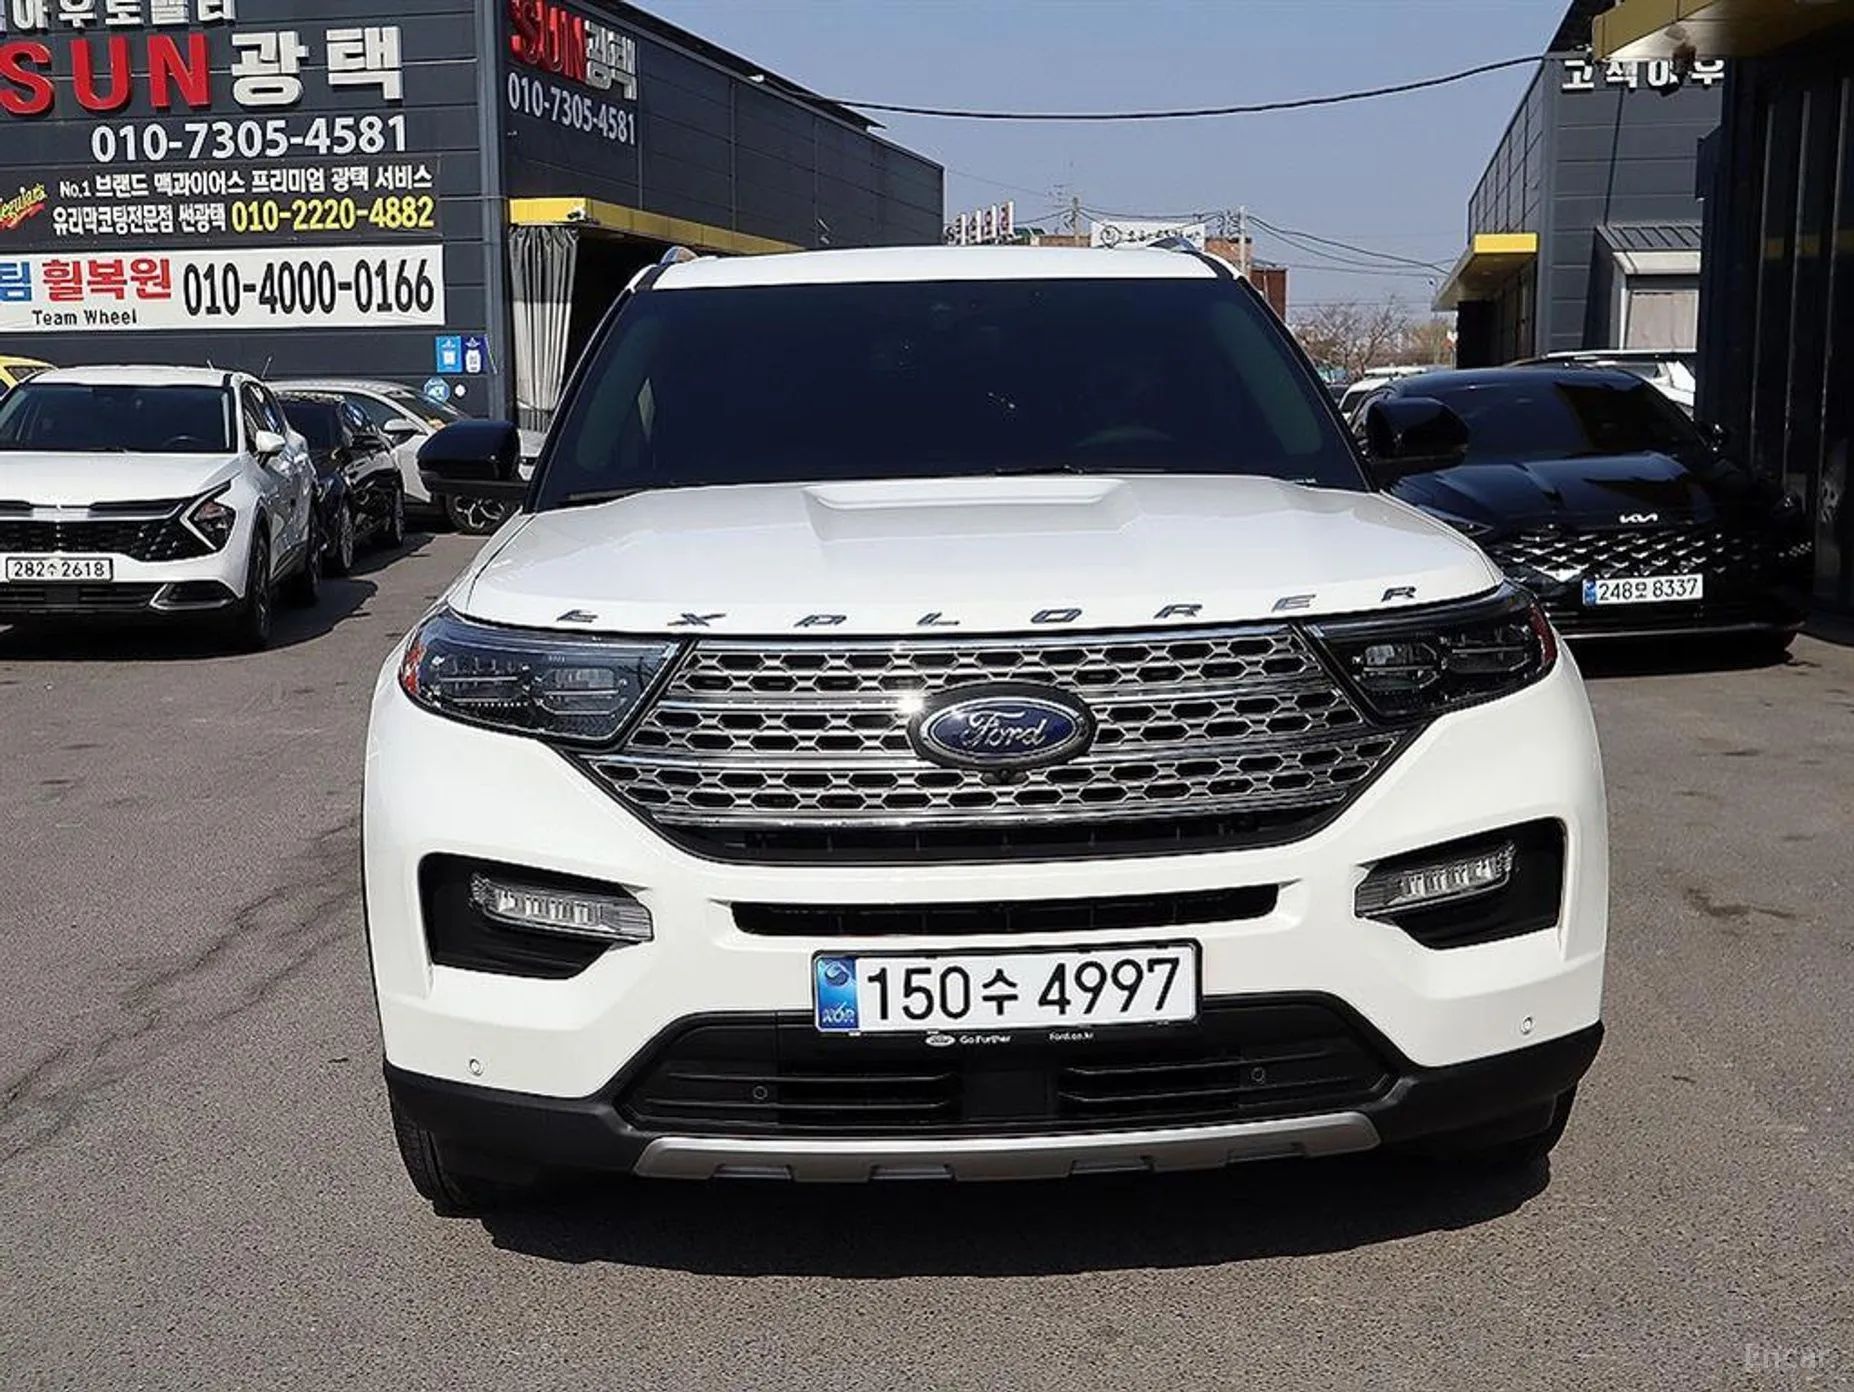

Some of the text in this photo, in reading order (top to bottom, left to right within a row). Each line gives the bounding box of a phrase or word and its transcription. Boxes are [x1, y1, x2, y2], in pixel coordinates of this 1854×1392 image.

[508, 72, 636, 146] 010-7305-4581
[91, 115, 406, 162] 010-7305-4581
[59, 165, 433, 199] No.1 브랜드 맥과이어스 프리미엄 광택 서비스
[52, 203, 174, 236] 유리막코팅전문점
[231, 196, 435, 232] 010-2220-4882
[41, 258, 172, 302] 휠복원
[183, 259, 435, 317] 010-4000-0166
[32, 309, 137, 326] Team Wheel
[61, 561, 105, 577] 2618
[1652, 577, 1699, 598] 8337
[556, 585, 1417, 628] EXPLORER
[960, 710, 1048, 747] Ford
[867, 957, 1181, 1020] 150수 4997
